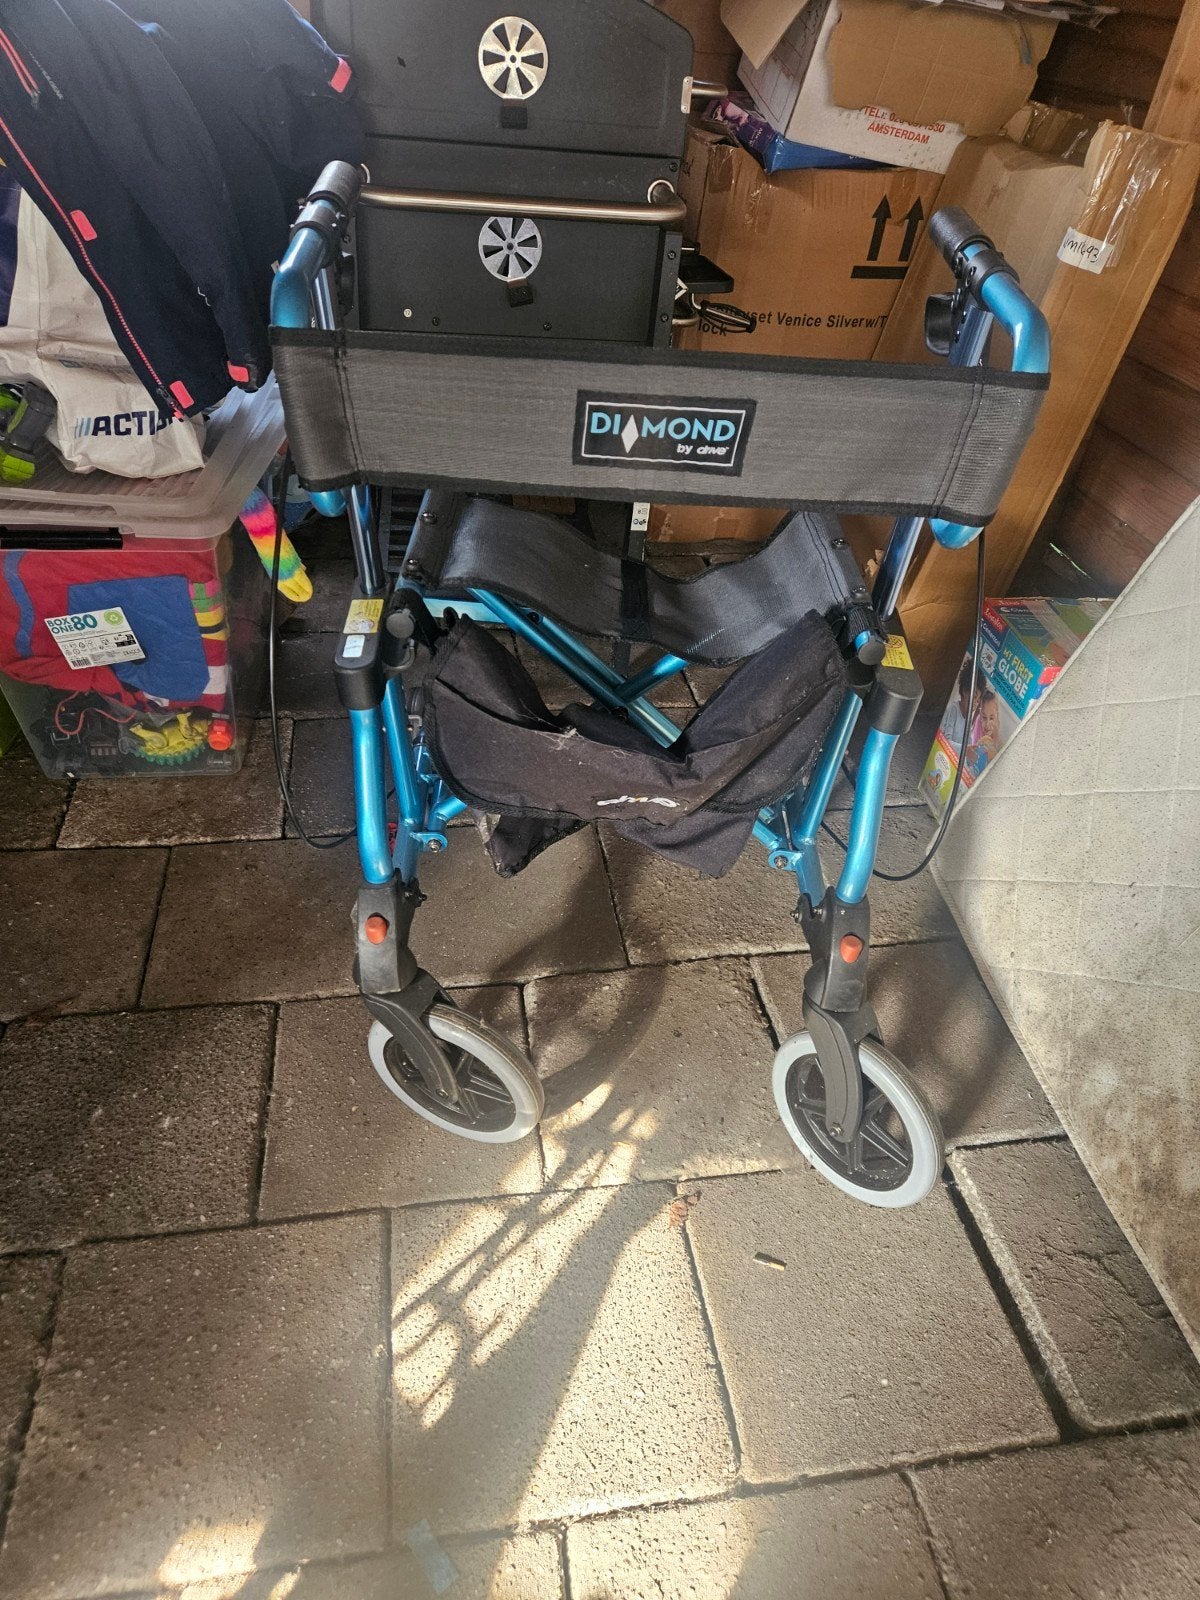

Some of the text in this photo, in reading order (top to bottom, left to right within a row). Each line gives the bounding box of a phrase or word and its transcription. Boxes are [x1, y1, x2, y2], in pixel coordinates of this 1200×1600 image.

[867, 122, 930, 144] AMSTERDAM
[777, 312, 822, 327] Venice
[92, 411, 173, 436] ACTI
[677, 443, 693, 455] by
[46, 617, 70, 627] BOX
[51, 624, 75, 634] ONE
[71, 614, 98, 631] 80
[1011, 655, 1034, 684] FIRST
[998, 658, 1029, 699] GLOBE
